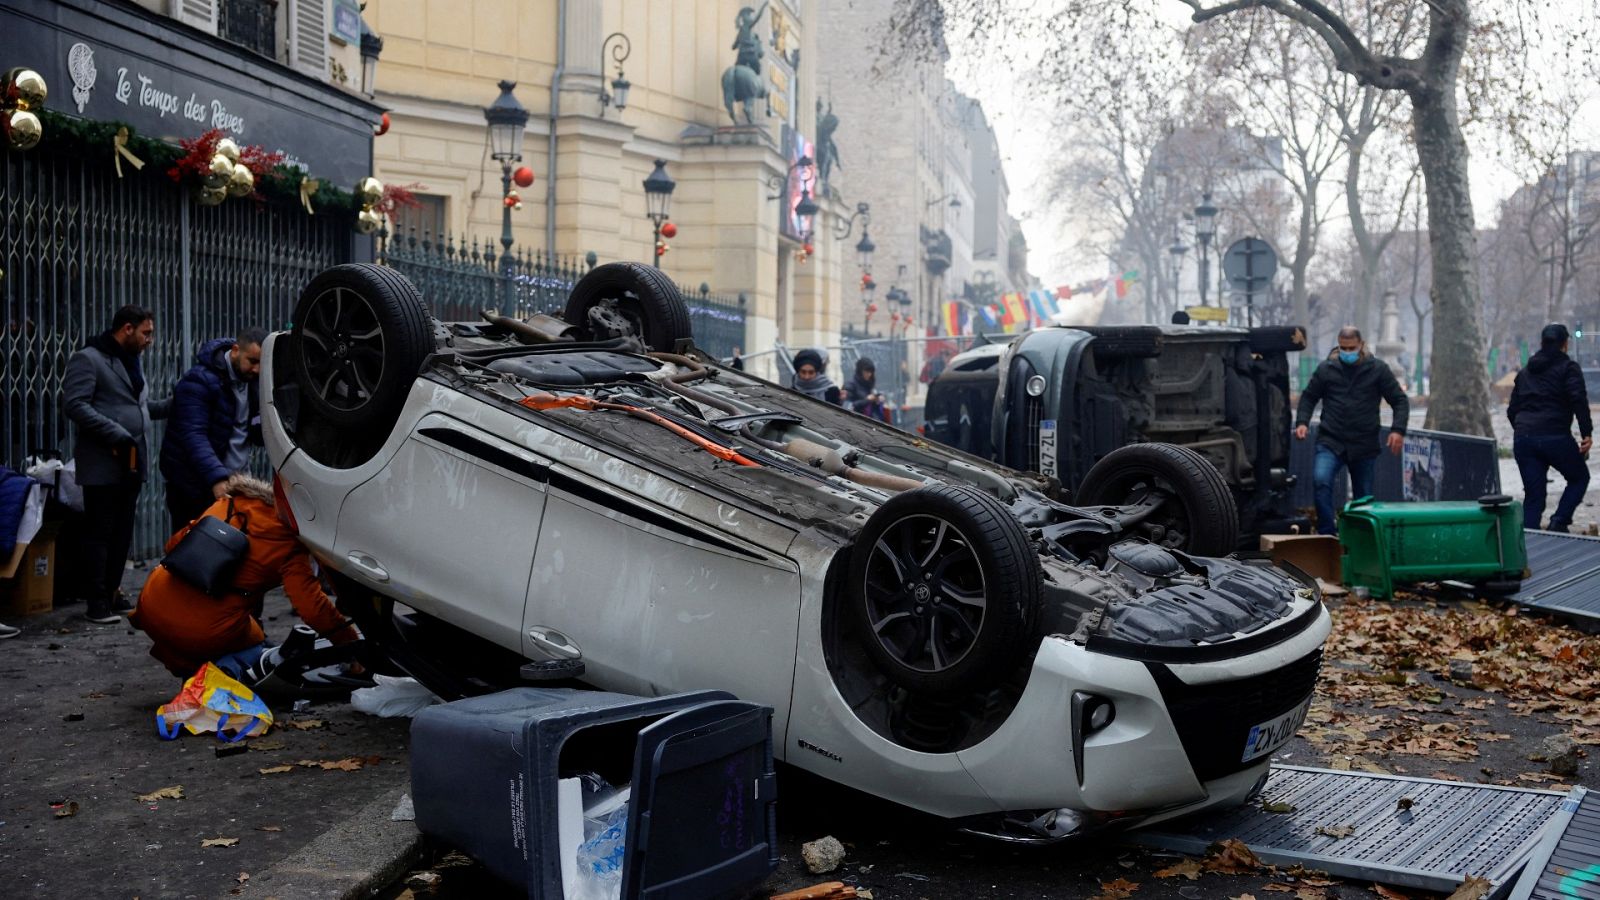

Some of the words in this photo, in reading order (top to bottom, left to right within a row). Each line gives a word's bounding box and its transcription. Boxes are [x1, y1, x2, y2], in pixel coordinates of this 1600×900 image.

[115, 67, 132, 105] Le
[138, 72, 179, 117] Temps
[184, 93, 206, 122] des
[211, 99, 244, 134] Rêves
